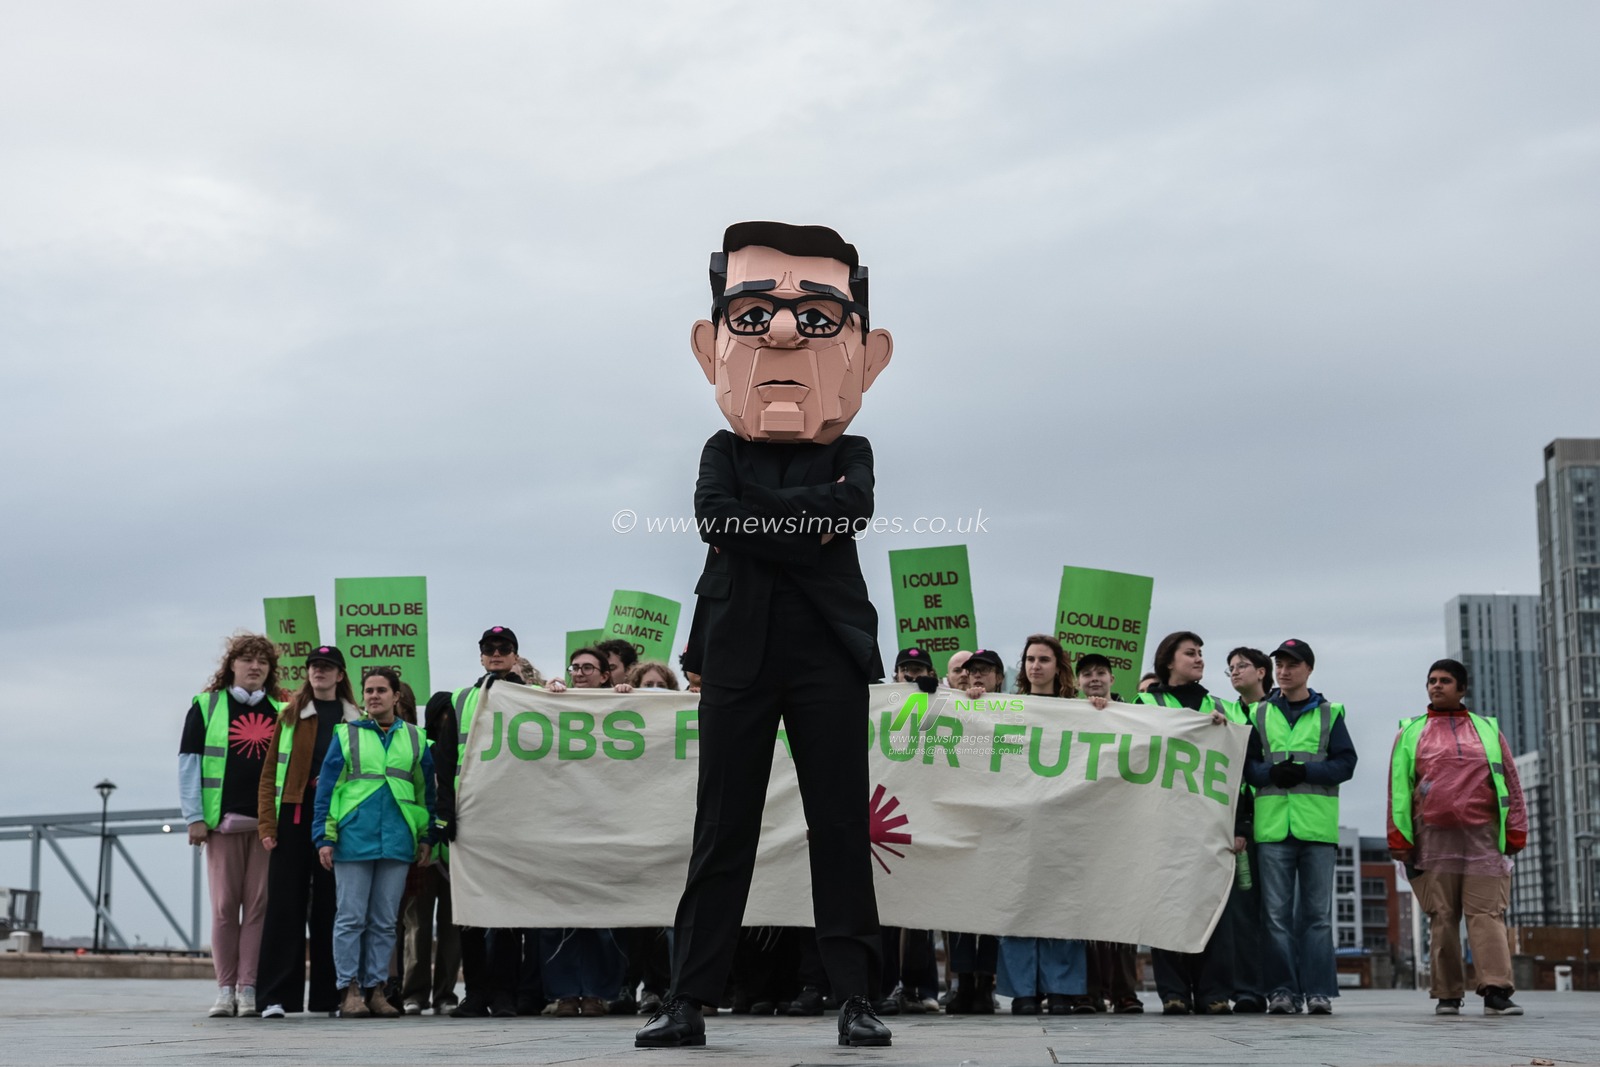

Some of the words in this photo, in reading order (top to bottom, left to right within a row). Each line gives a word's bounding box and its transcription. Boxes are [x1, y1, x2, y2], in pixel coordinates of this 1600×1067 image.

[909, 571, 958, 588] COULD
[346, 603, 401, 616] COULD
[404, 602, 423, 615] BE
[924, 594, 942, 609] BE
[613, 605, 670, 626] NATIONAL
[899, 614, 970, 633] PLANTING
[1067, 611, 1120, 631] COULD
[1122, 618, 1142, 634] BE
[346, 623, 418, 637] FIGHTING
[612, 623, 664, 642] CLIMATE
[916, 637, 960, 652] TREES
[1058, 631, 1138, 653] PROTECTING
[350, 644, 415, 658] CLIMATE
[1106, 655, 1132, 671] ERS
[480, 710, 646, 761] JOBS
[869, 711, 964, 769] UR
[990, 723, 1230, 806] FUTURE
